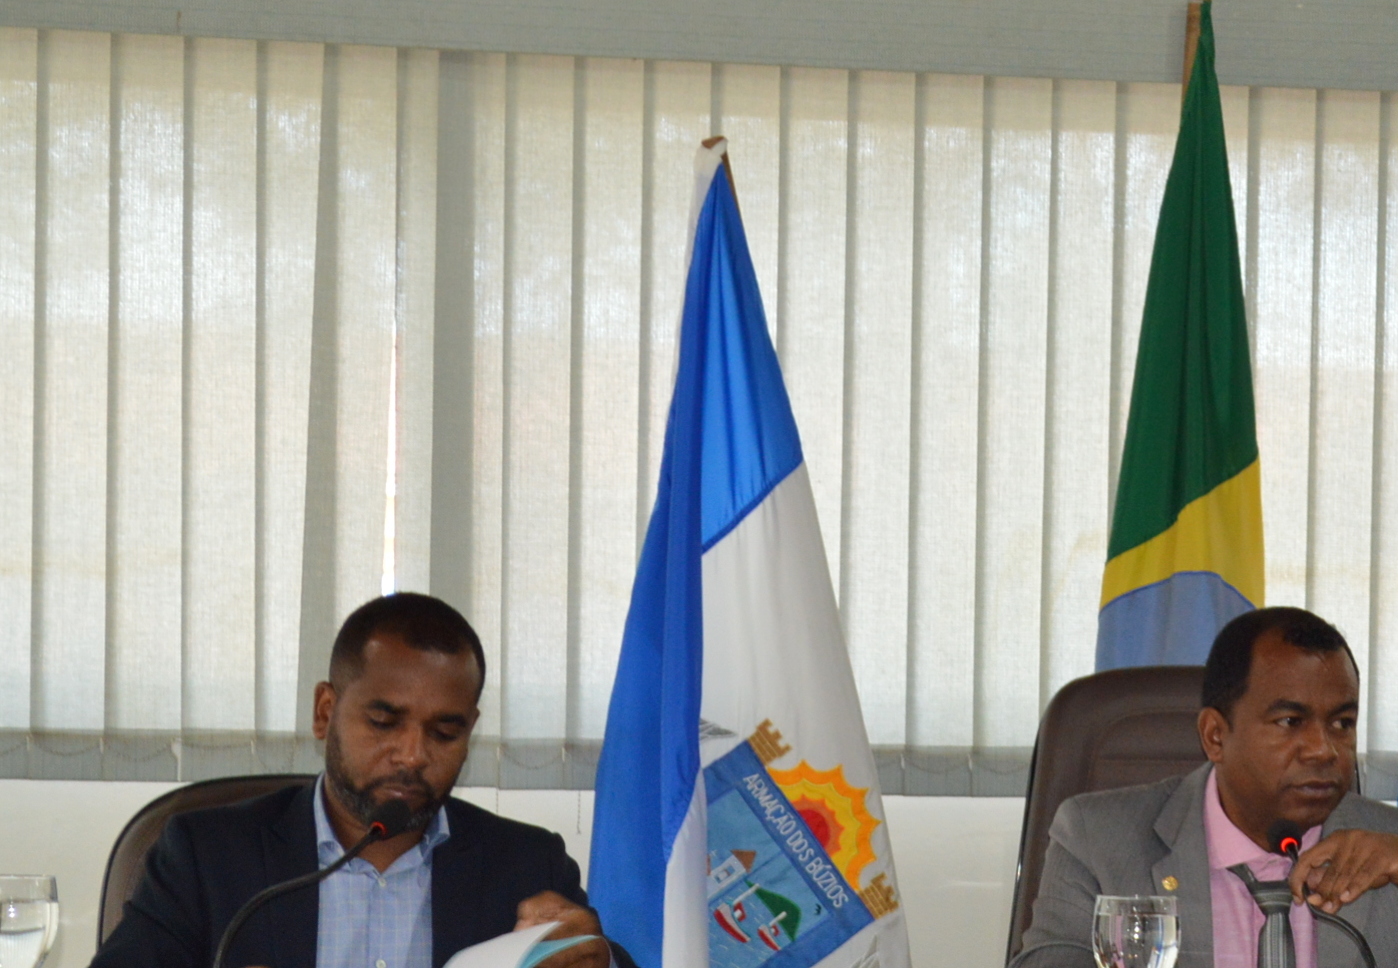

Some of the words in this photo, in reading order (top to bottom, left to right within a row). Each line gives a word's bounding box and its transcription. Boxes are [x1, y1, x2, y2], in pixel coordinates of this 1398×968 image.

[743, 773, 796, 836] ARMAÇÃO
[786, 830, 815, 861] DOS
[805, 856, 849, 908] BÚZIOS
